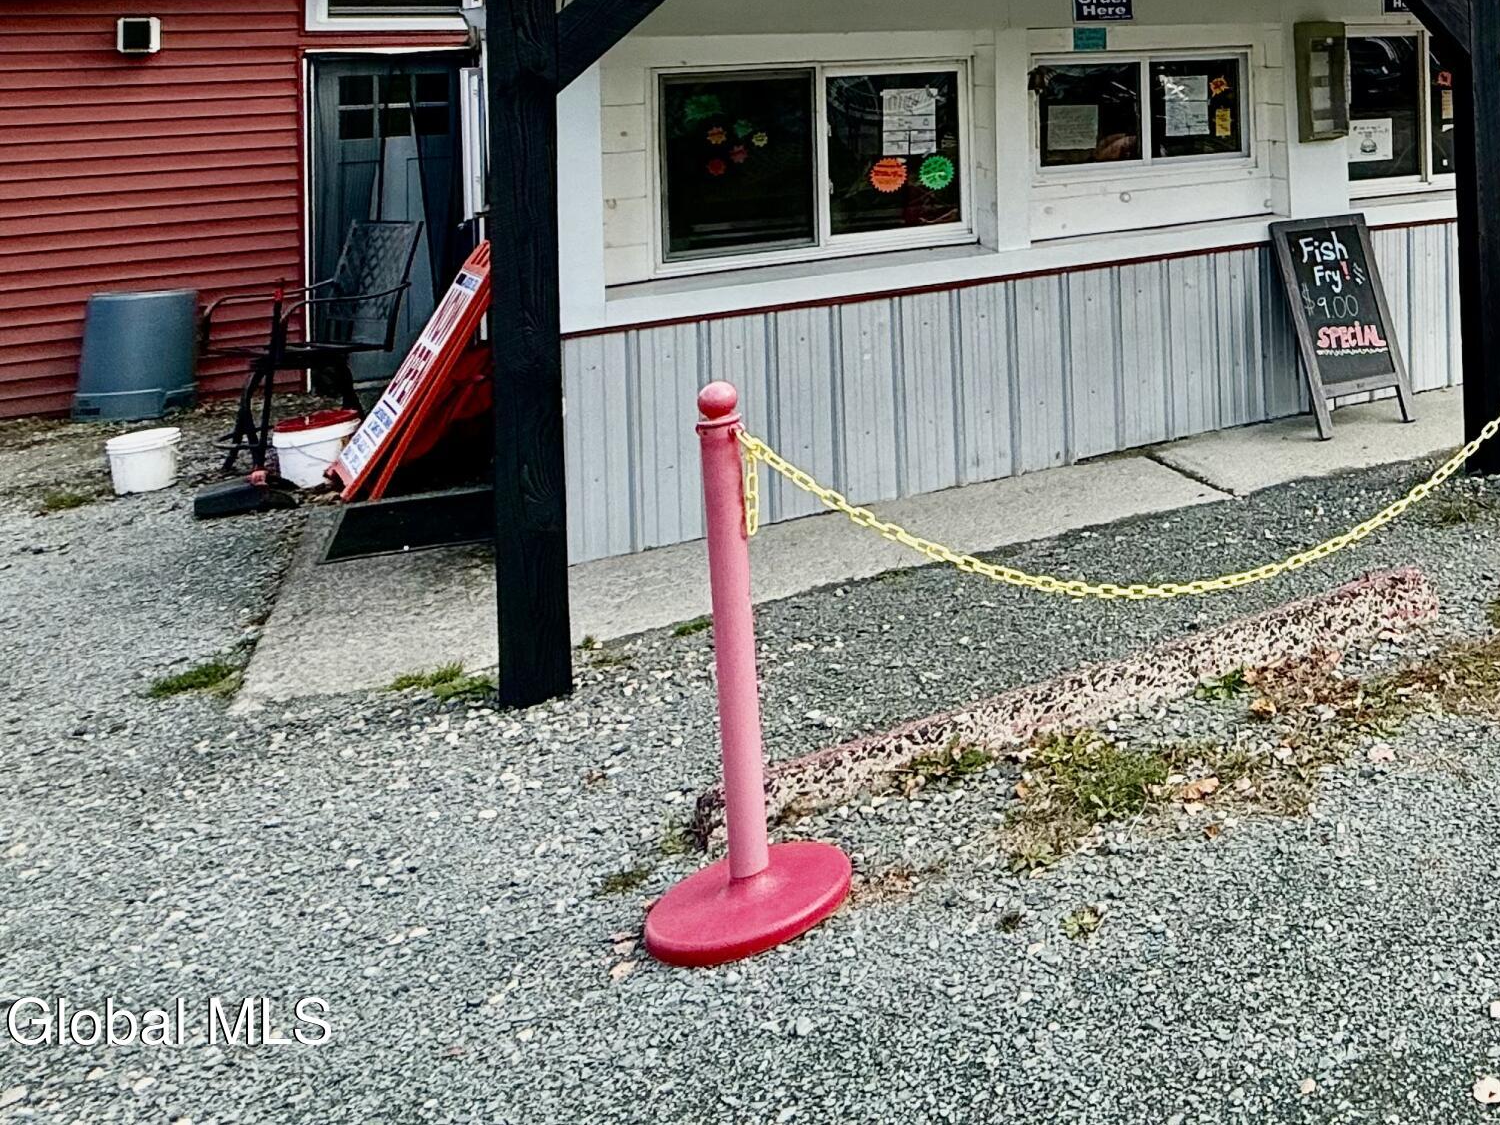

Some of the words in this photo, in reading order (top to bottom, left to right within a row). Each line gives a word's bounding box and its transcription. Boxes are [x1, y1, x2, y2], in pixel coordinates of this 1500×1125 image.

[1082, 5, 1126, 16] Here
[1299, 231, 1349, 263] Fish
[1313, 261, 1351, 293] Fry!
